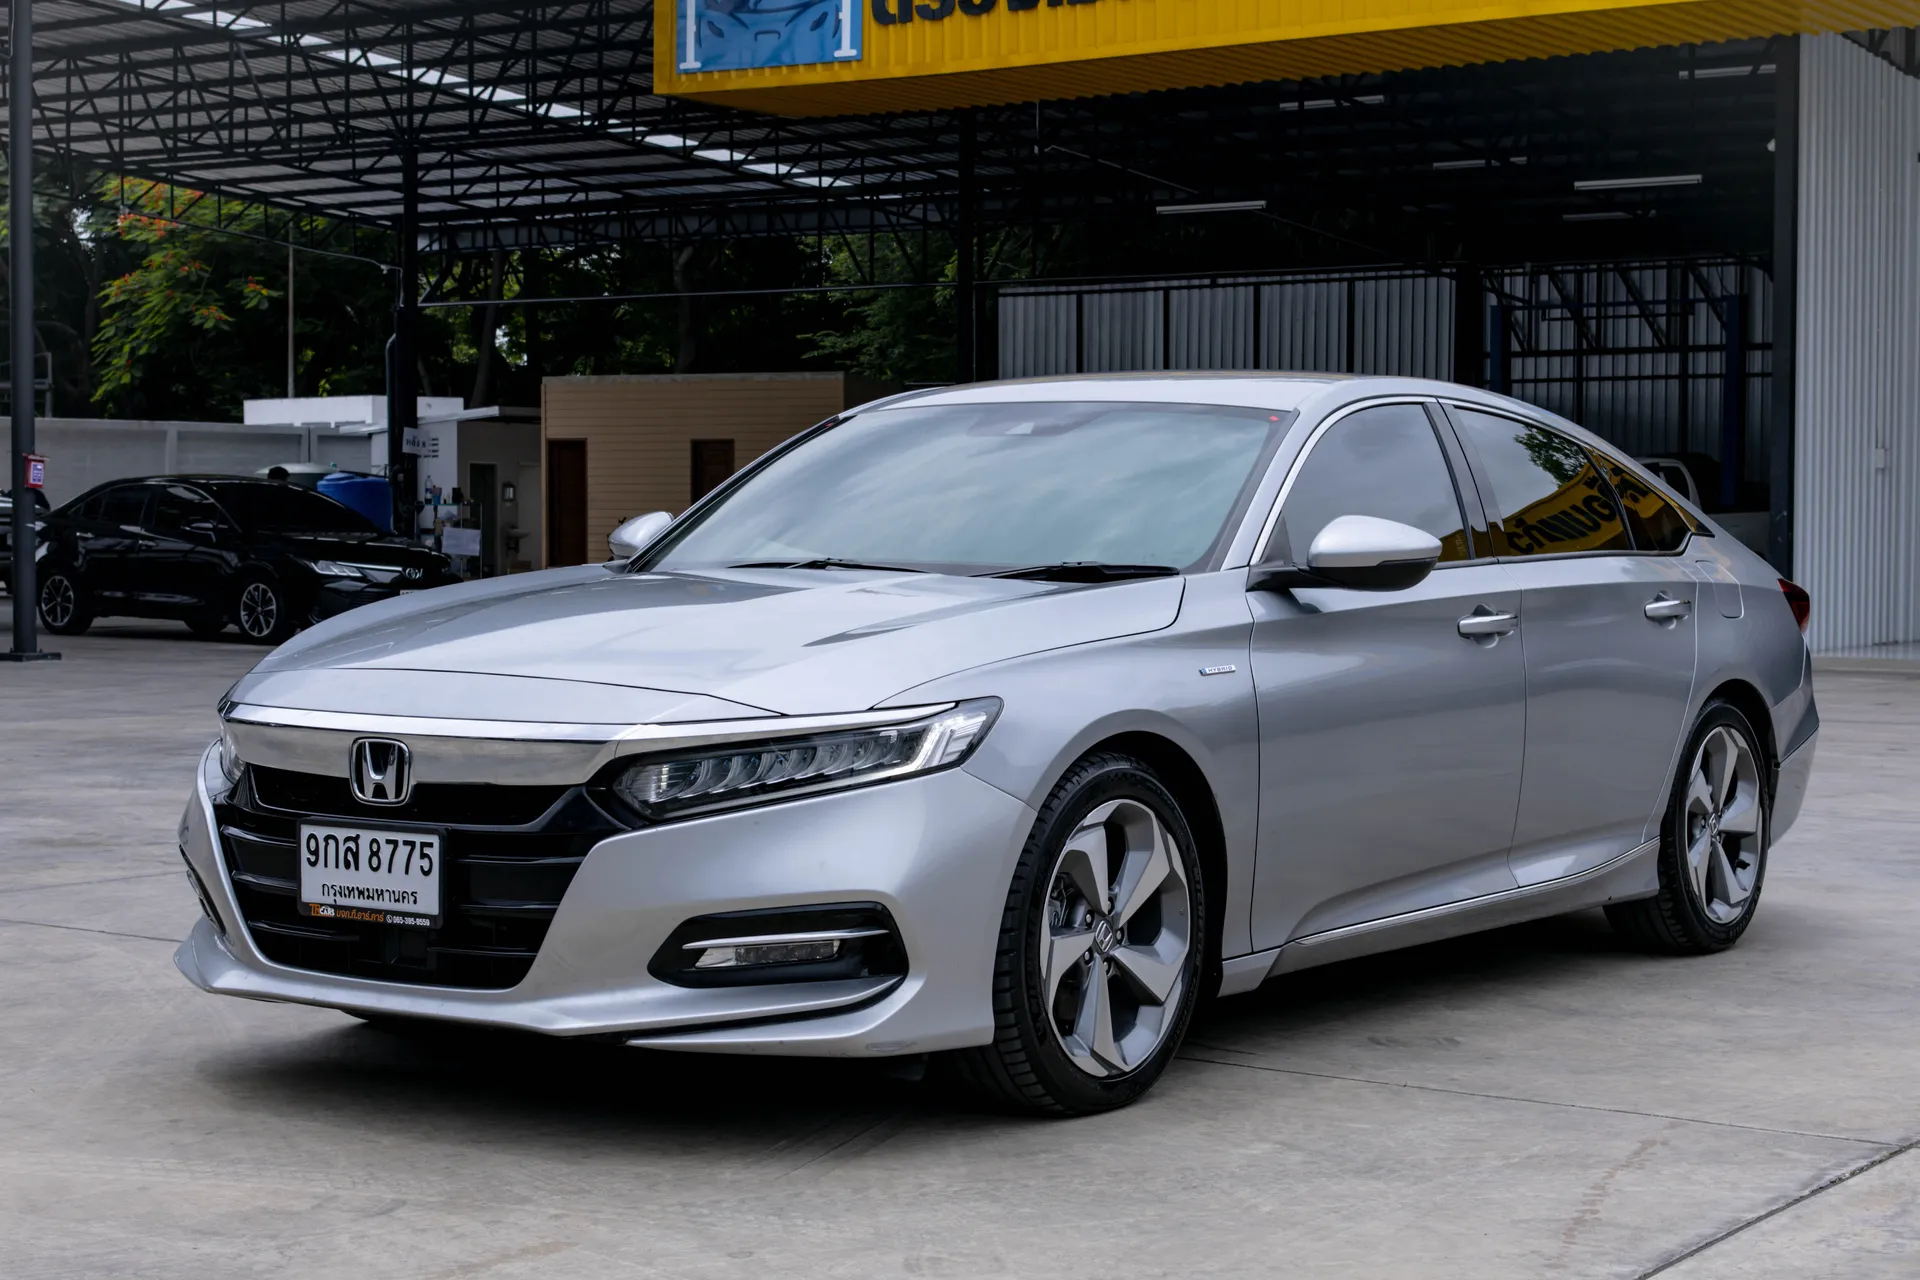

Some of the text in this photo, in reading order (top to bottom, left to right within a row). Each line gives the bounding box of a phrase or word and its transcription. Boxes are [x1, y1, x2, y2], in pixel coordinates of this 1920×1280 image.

[306, 832, 434, 877] 9กส 8775
[321, 882, 418, 905] กรุงเทพมหานคร
